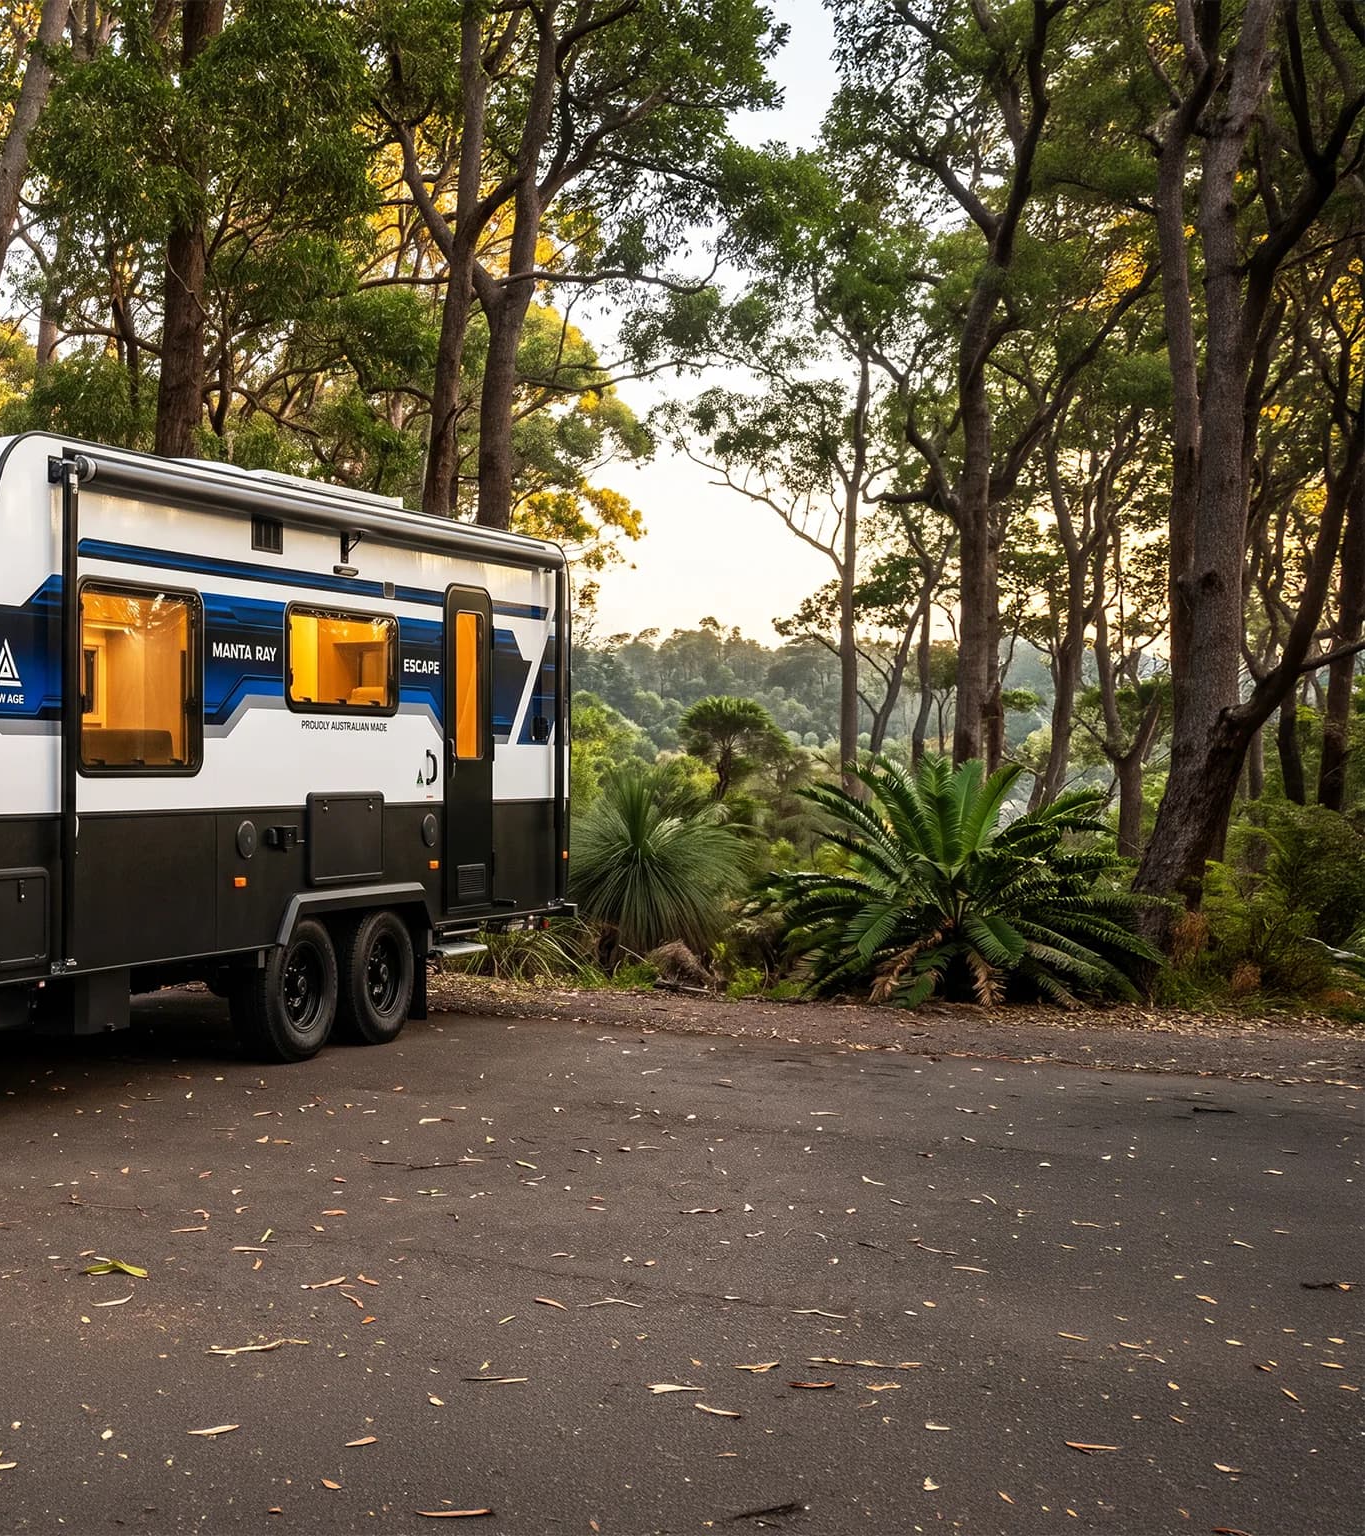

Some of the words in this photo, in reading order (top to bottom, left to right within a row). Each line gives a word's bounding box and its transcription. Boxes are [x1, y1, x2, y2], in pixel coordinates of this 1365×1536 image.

[212, 642, 252, 660] MANTA
[255, 646, 277, 662] RAY
[403, 658, 440, 675] ESCAPE
[6, 694, 24, 704] AGE
[331, 721, 369, 731] AUSTRALIAN
[370, 722, 388, 732] MADE
